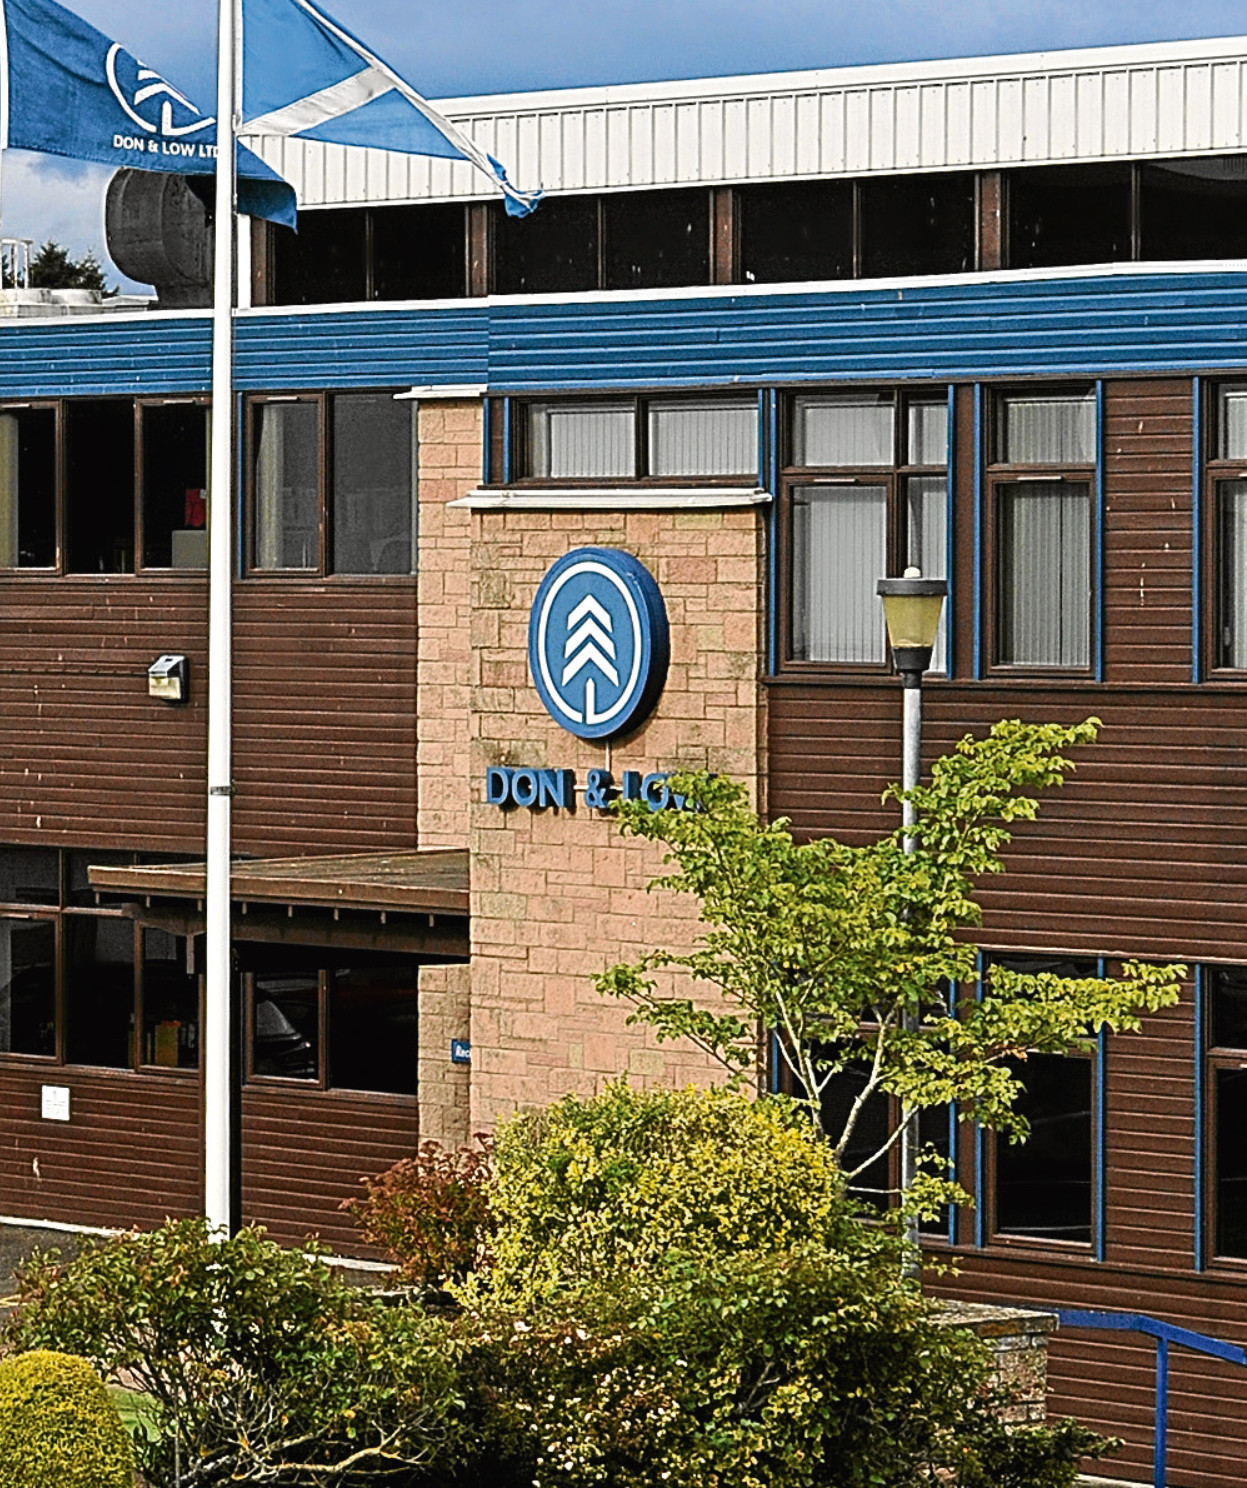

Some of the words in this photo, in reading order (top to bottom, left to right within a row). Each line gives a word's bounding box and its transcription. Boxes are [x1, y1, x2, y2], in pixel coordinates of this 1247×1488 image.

[113, 134, 144, 151] DON
[147, 140, 159, 153] &
[161, 141, 195, 157] LOW
[486, 766, 567, 808] DON
[584, 768, 614, 809] &
